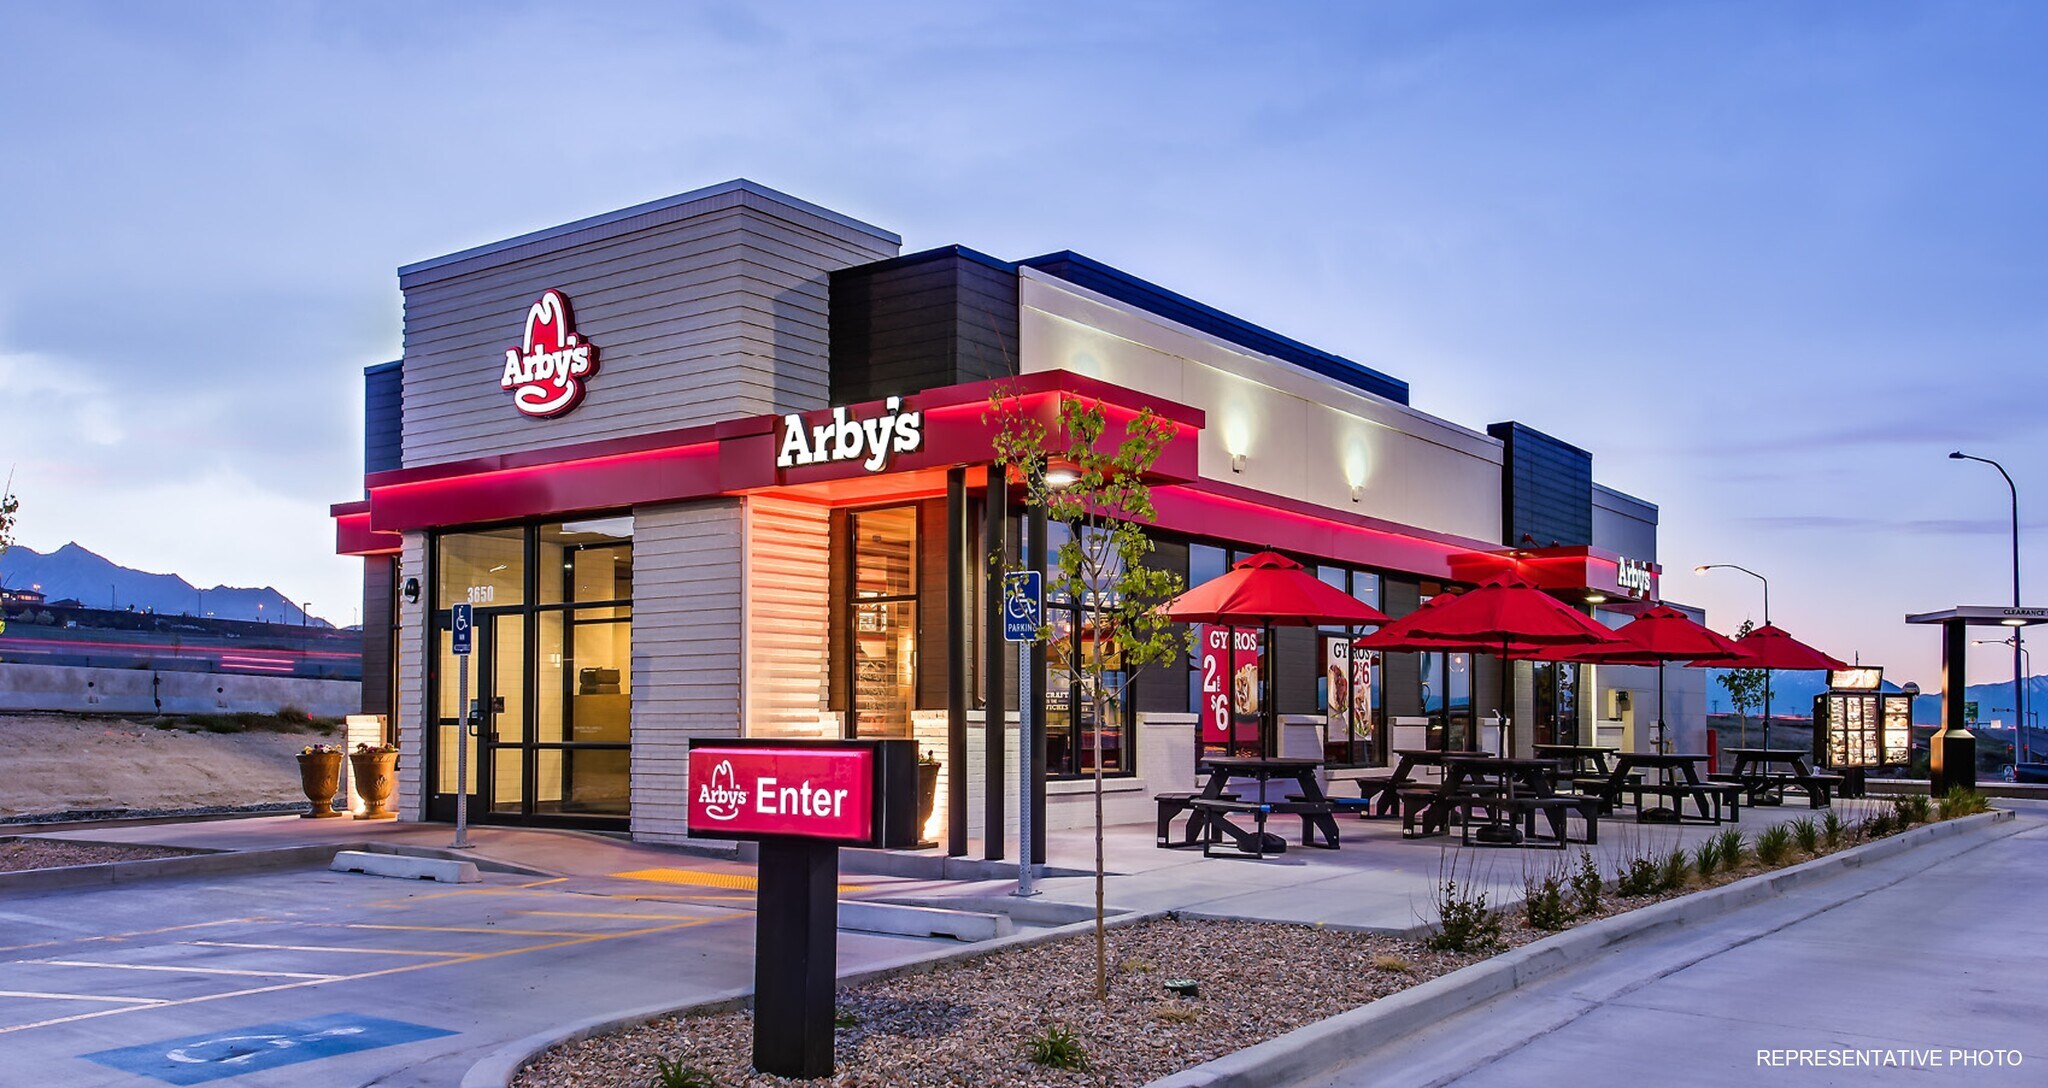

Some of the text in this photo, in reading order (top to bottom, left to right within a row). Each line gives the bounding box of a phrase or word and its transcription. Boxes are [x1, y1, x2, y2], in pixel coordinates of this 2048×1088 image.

[501, 335, 588, 387] Arby's
[777, 396, 921, 472] Arby's
[467, 585, 494, 603] 3650
[1618, 556, 1651, 597] Arby's
[1210, 630, 1257, 651] GYROS
[1203, 654, 1217, 692] 2
[698, 776, 848, 818] Arby's Enter
